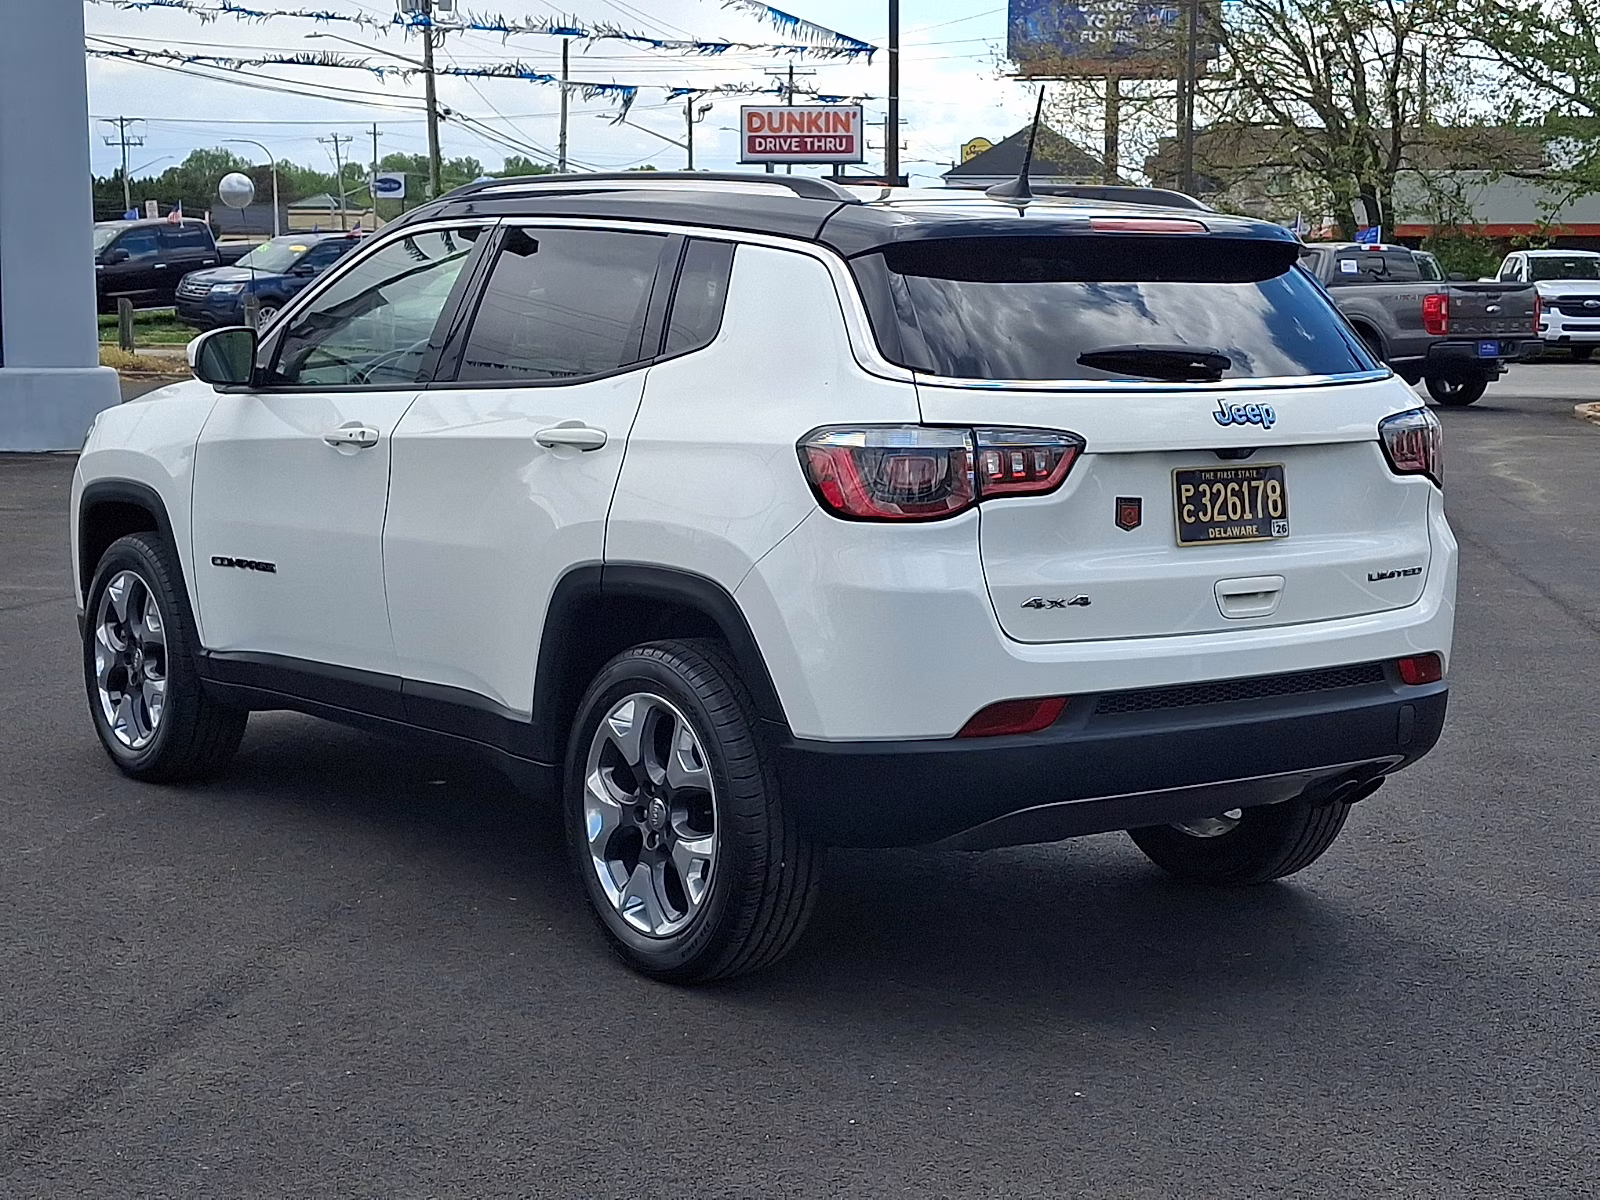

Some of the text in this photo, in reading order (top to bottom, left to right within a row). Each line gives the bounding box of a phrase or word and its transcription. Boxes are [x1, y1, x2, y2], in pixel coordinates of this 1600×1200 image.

[747, 111, 857, 133] DUNKIN'
[755, 138, 846, 151] DRIVE THRU
[1212, 398, 1277, 430] Jeep
[1202, 470, 1258, 480] THE FIRST STATE
[1198, 480, 1282, 522] 326178
[1208, 525, 1259, 538] DELAWARE
[1276, 524, 1287, 534] 26
